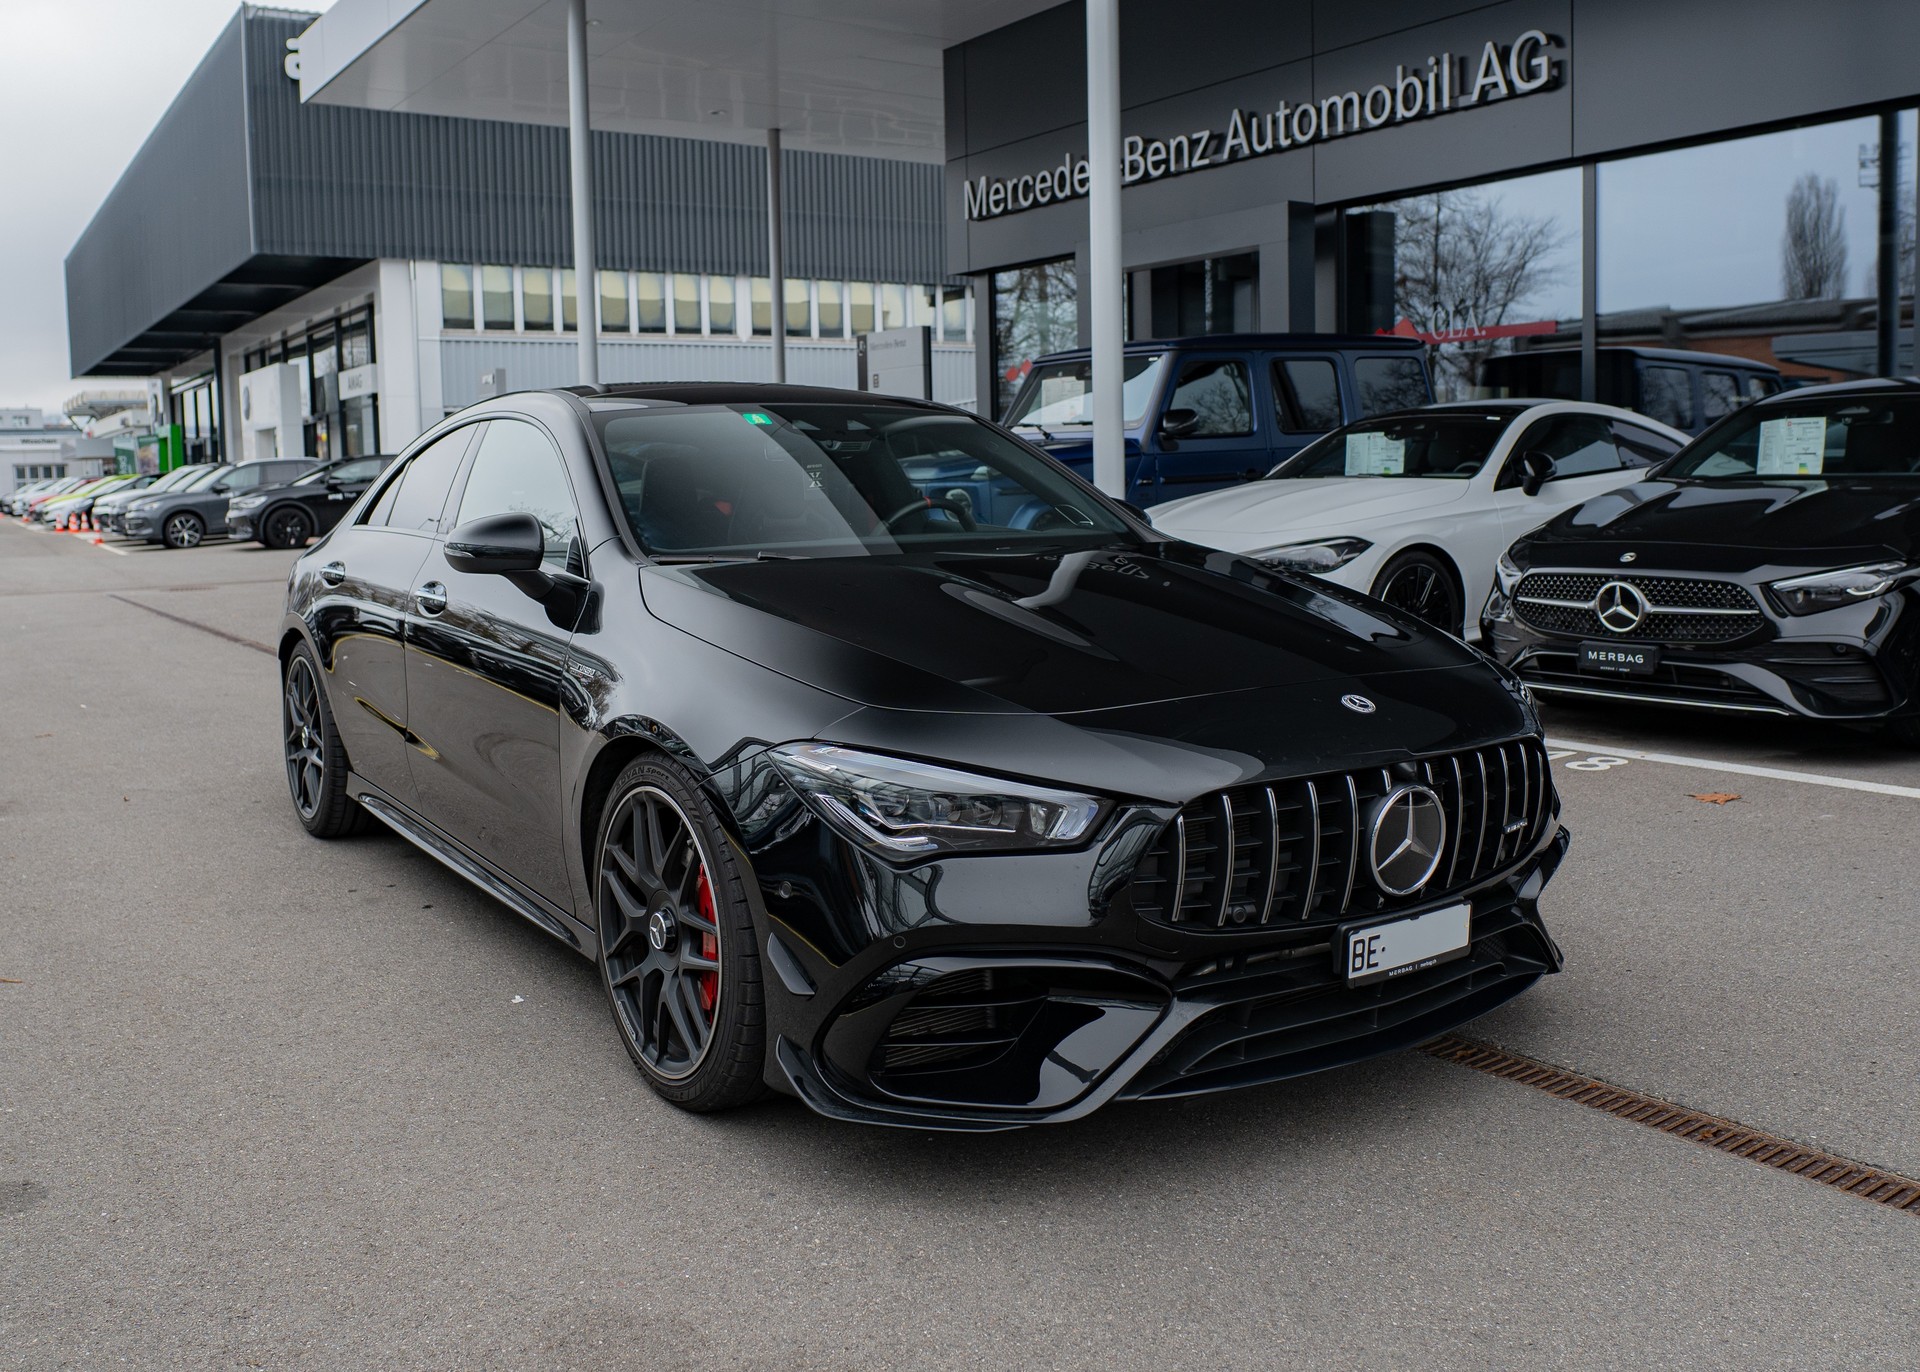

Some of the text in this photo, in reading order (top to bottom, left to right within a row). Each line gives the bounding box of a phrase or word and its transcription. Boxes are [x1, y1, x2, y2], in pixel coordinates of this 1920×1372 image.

[1222, 52, 1451, 159] Automobil
[1471, 29, 1550, 102] AG
[1588, 651, 1644, 664] MERBAG
[1388, 966, 1413, 977] MERBAG
